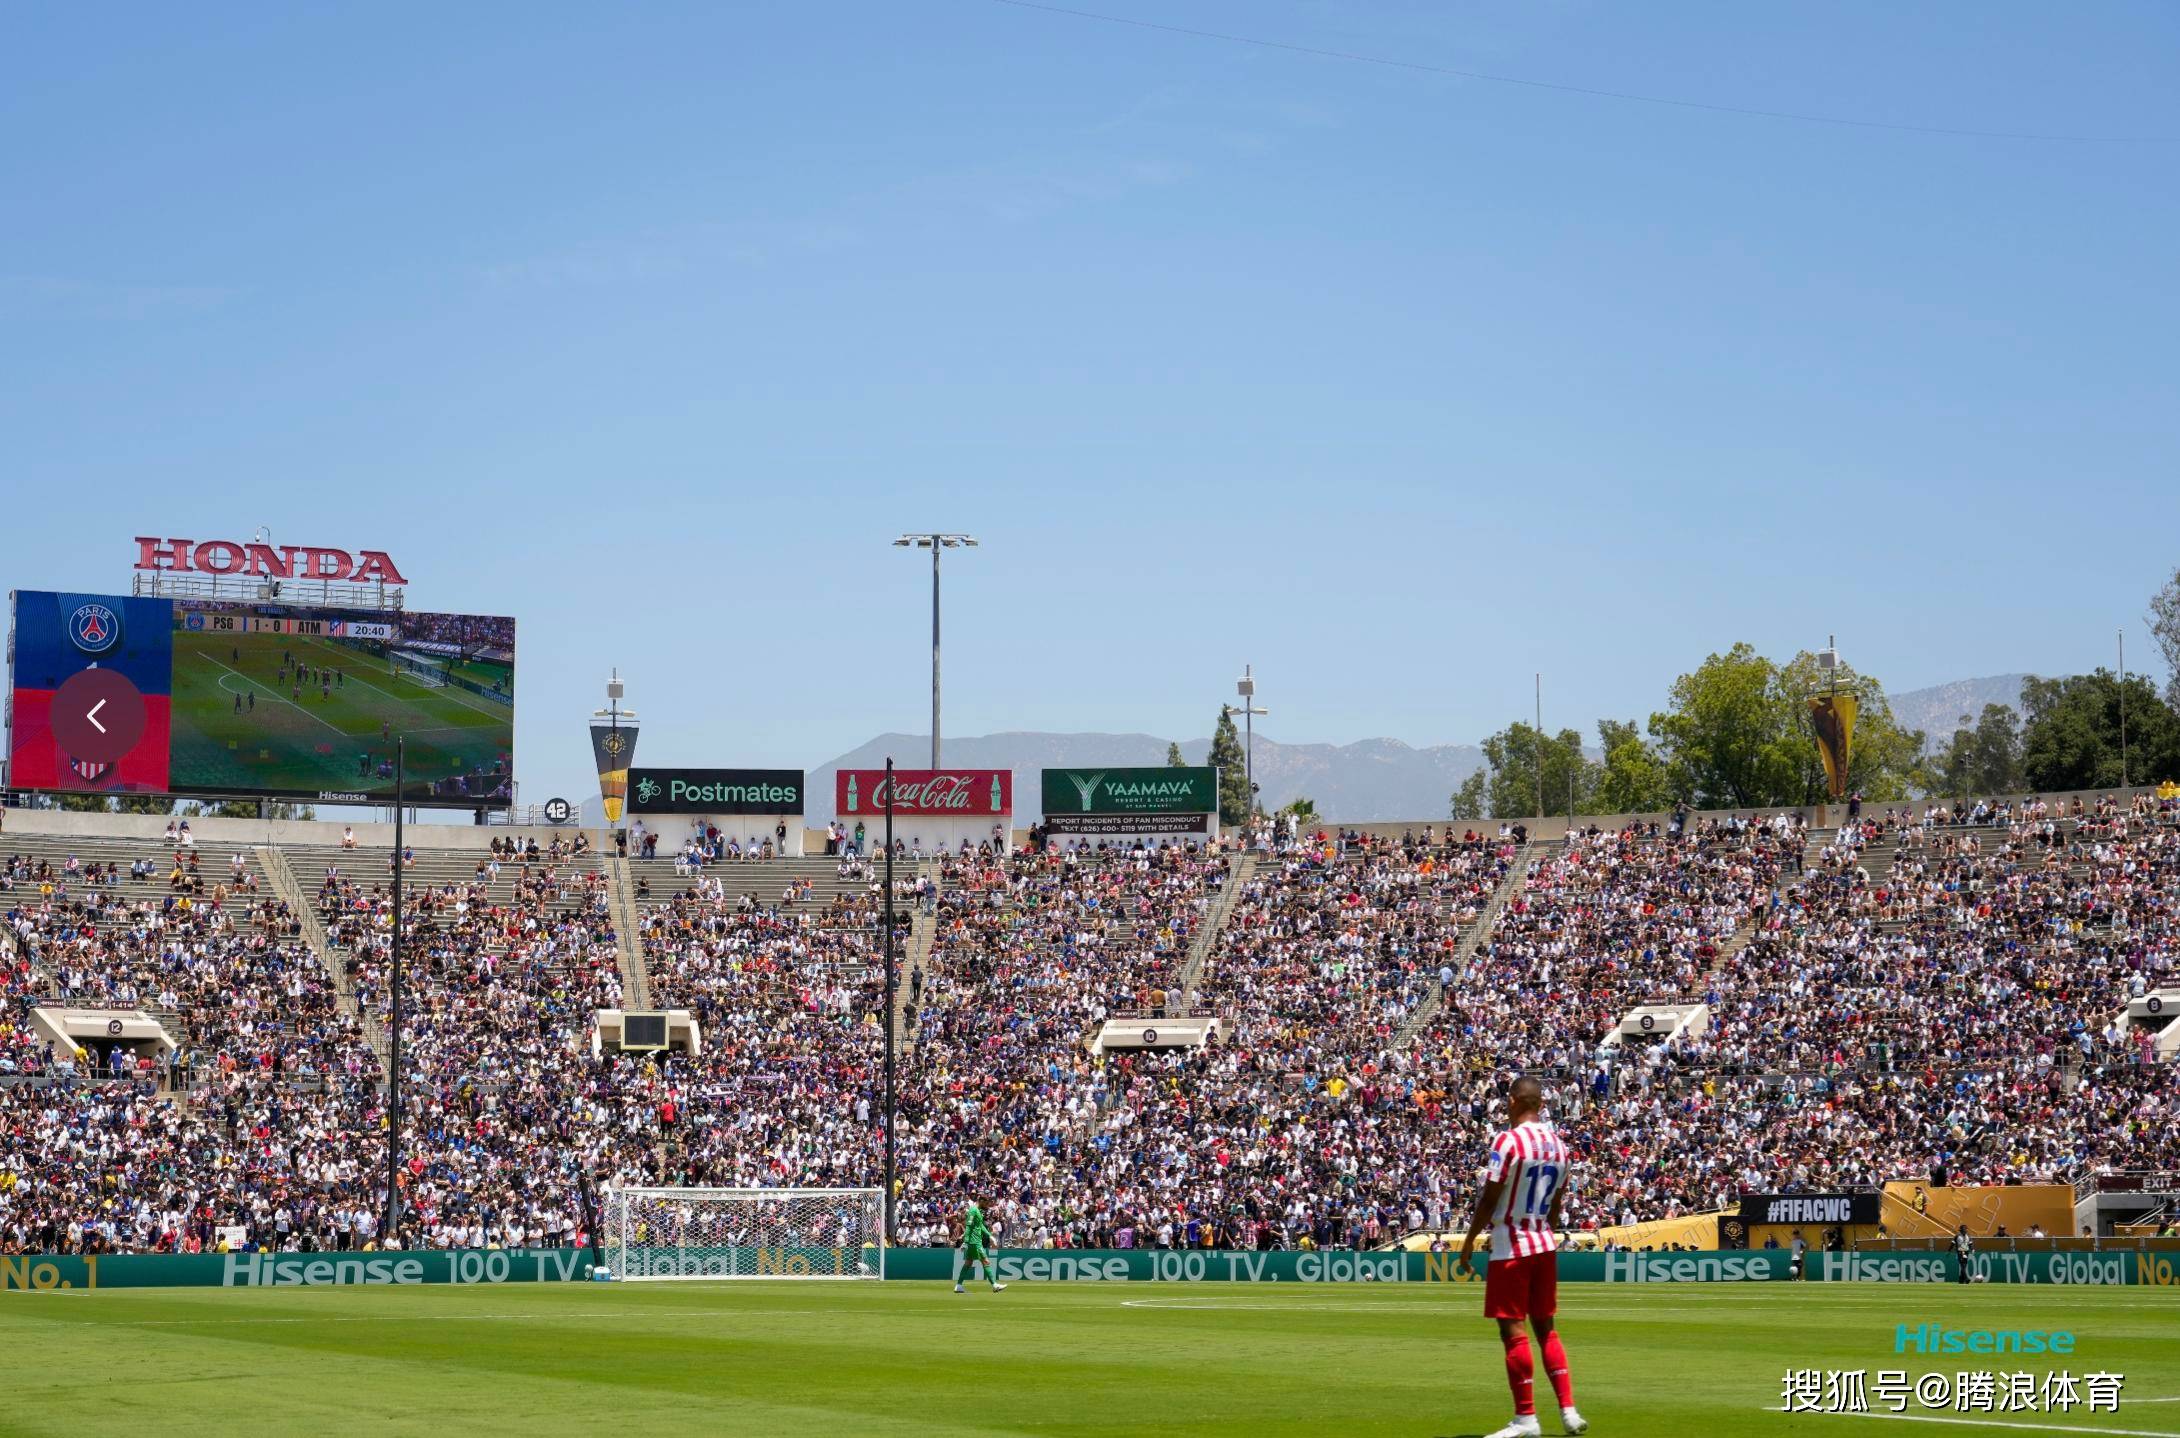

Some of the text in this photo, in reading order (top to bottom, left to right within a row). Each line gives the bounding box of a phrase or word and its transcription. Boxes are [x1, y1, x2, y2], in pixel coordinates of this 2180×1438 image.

[133, 536, 409, 585] HONDA
[77, 606, 110, 620] PARIS
[213, 616, 234, 630] PSG
[273, 619, 281, 632] 0
[297, 622, 321, 634] ATM
[354, 625, 385, 636] 20:40
[318, 791, 368, 801] Hisense
[671, 780, 797, 803] Postmates
[546, 802, 567, 819] 42
[1082, 817, 1122, 825] INCIDENTS
[2150, 1000, 2159, 1011] 8
[111, 1022, 121, 1032] 12
[1643, 1018, 1651, 1028] 9
[1145, 1032, 1155, 1041] 10
[1525, 1165, 1559, 1215] 12
[2142, 1178, 2173, 1189] EXIT
[1767, 1198, 1850, 1223] #FIFACWC
[0, 1255, 97, 1290] No. 1
[223, 1254, 424, 1288] Hisense
[952, 1249, 1130, 1282] Hisense
[1296, 1253, 1408, 1283] Global
[1425, 1253, 1482, 1283] No.
[1604, 1252, 1771, 1283] Hisense
[1823, 1251, 1946, 1283] Hisense
[2049, 1253, 2126, 1285] Global
[2137, 1253, 2180, 1286] No.
